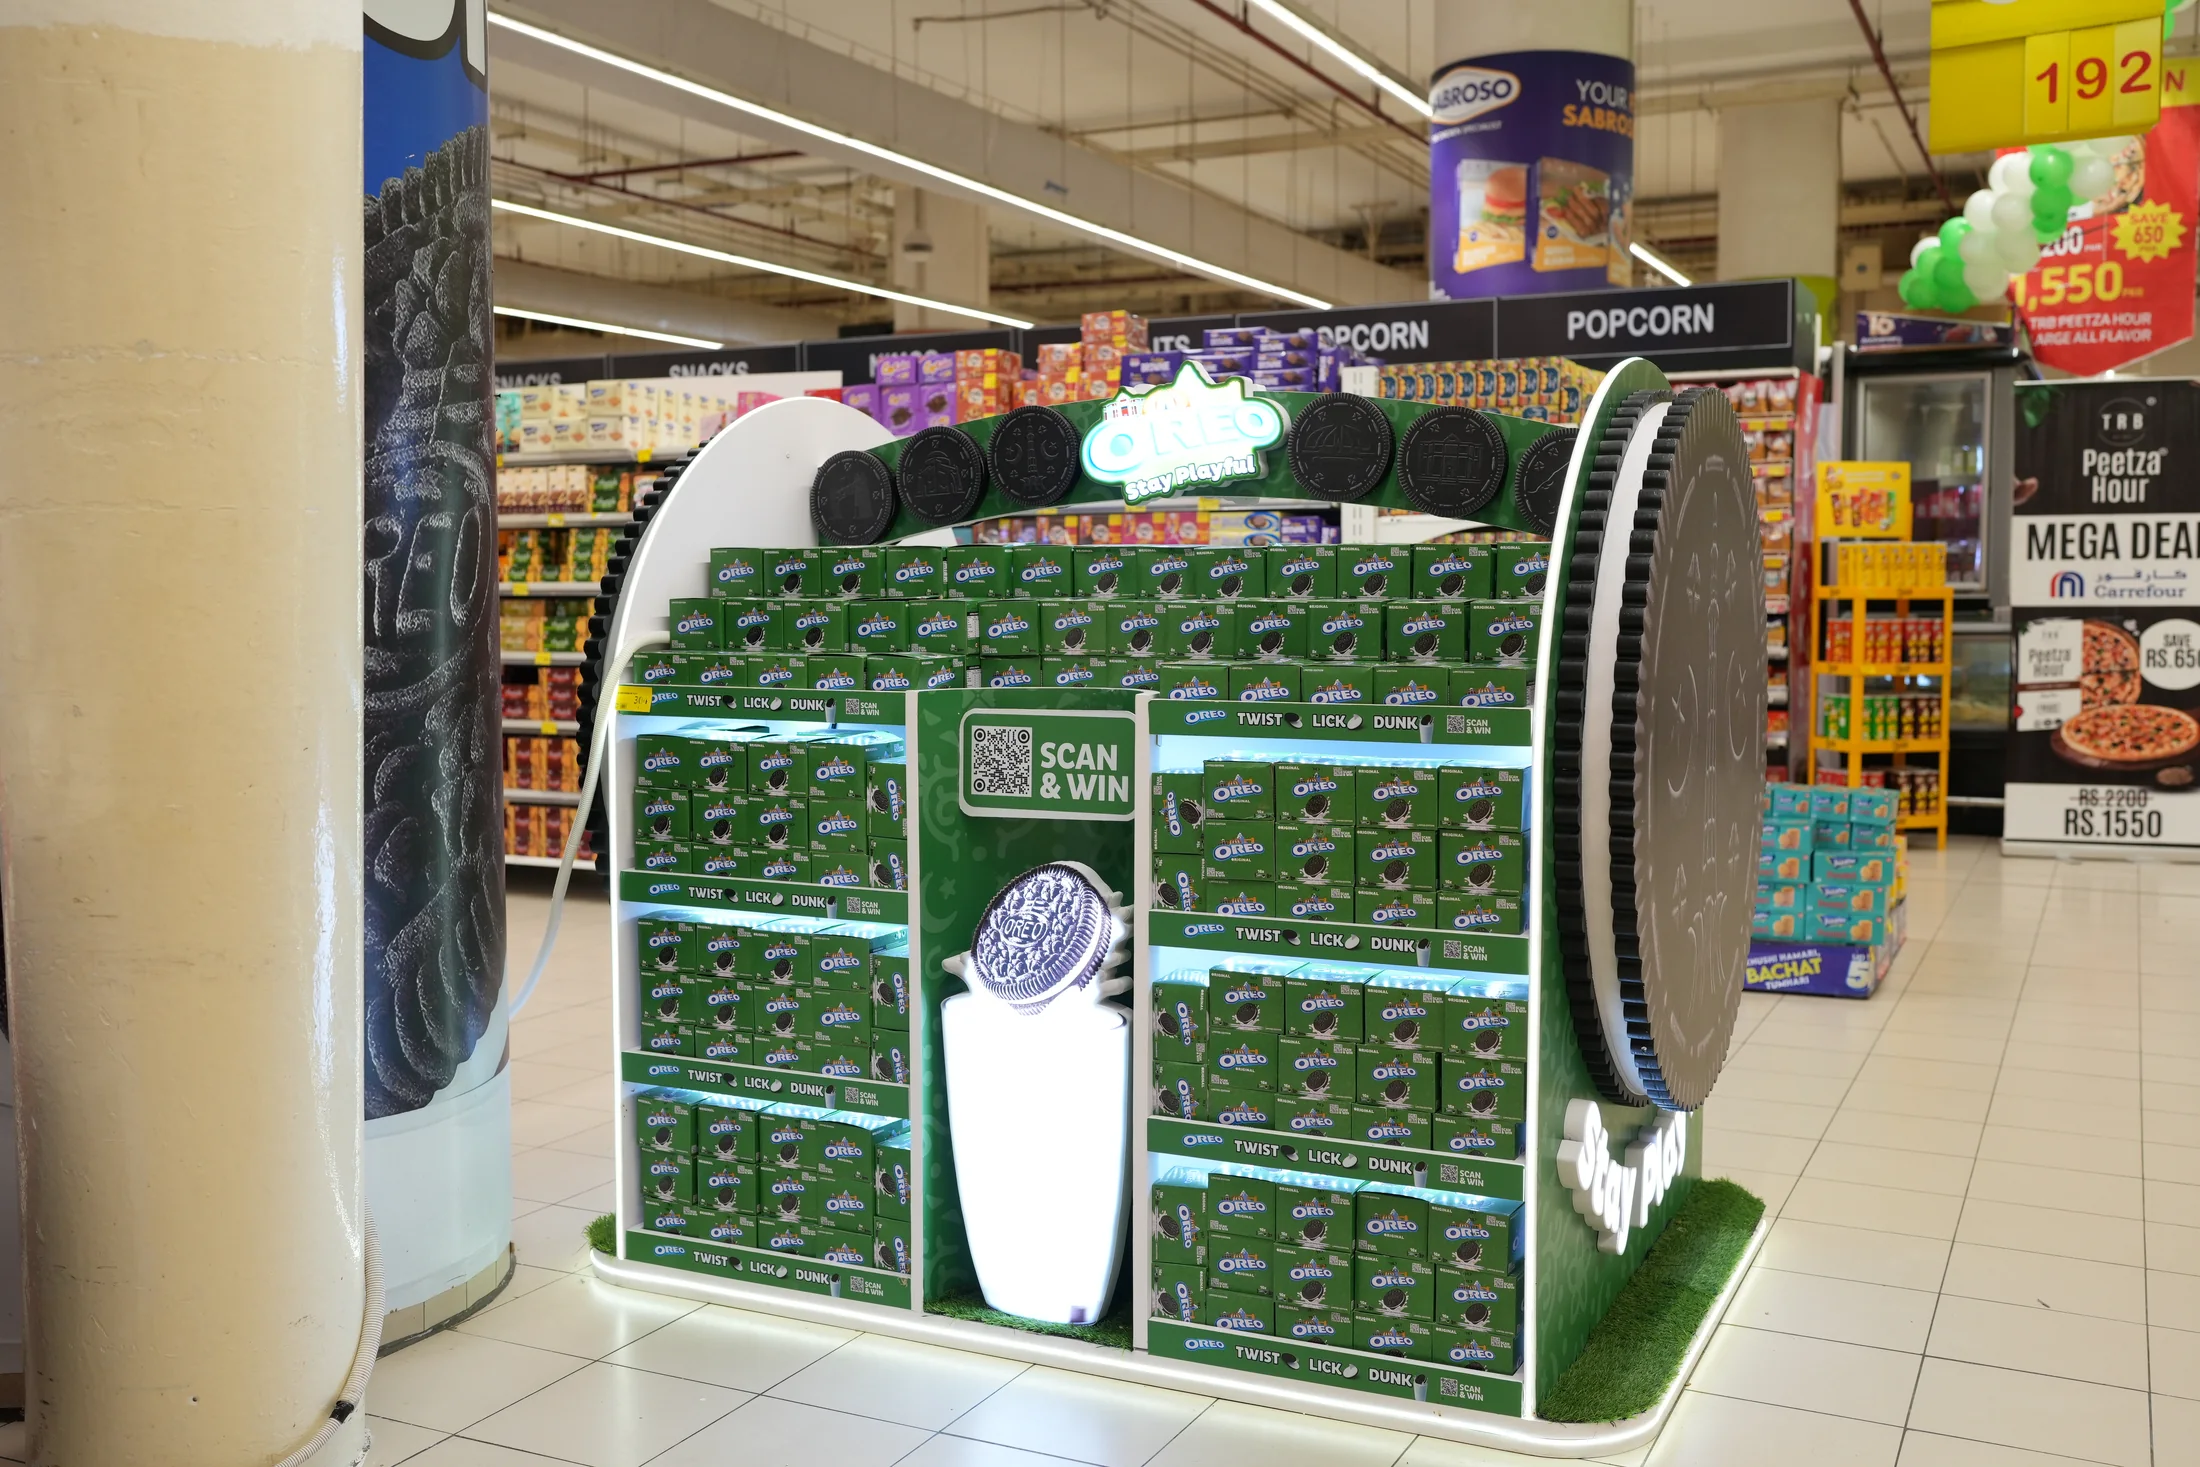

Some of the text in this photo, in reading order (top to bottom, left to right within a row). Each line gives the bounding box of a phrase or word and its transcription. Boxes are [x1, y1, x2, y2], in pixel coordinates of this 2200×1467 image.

[2036, 51, 2152, 104] 192
[1433, 79, 1512, 110] ABROSO
[1576, 79, 1627, 106] YOUR
[2130, 213, 2168, 225] SAVE
[2133, 226, 2164, 244] 650
[2011, 261, 2123, 312] 1,550
[1567, 303, 1714, 340] POPCORN
[2058, 314, 2111, 329] PEETZA
[2112, 312, 2152, 326] HOUR
[2034, 328, 2152, 346] ARGE ALL FLAVOR
[1089, 404, 1277, 473] OREO
[2082, 448, 2161, 477] Peetza
[1125, 455, 1256, 501] Stay Playful
[2092, 476, 2149, 503] Hour
[2027, 521, 2200, 560] MEGA DEA
[718, 565, 754, 583] OREO
[895, 565, 933, 583] OREO
[954, 565, 996, 583] OREO
[1021, 565, 1062, 582] OREO
[1088, 560, 1123, 575] OREO
[1151, 560, 1187, 576] OREO
[1281, 560, 1319, 577] OREO
[1353, 560, 1393, 576] OREO
[2094, 585, 2186, 599] Carrefour
[677, 617, 713, 634] OREO
[856, 620, 896, 637] OREO
[987, 620, 1029, 638] OREO
[1054, 615, 1092, 630] OREO
[1250, 618, 1290, 633] OREO
[1402, 619, 1445, 636] OREO
[2163, 634, 2191, 647] SAVE
[687, 695, 721, 706] TWIST
[744, 697, 769, 709] LICK
[790, 699, 824, 711] DUNK
[1185, 710, 1417, 730] OREO TWIST LICK DUNK
[644, 756, 679, 769] OREO
[760, 757, 792, 769] OREO
[1040, 742, 1117, 771] SCAN
[816, 765, 855, 779] OREO
[1039, 771, 1128, 802] & WIN
[1213, 784, 1262, 801] OREO
[1293, 781, 1337, 797] OREO
[1373, 784, 1418, 799] OREO
[1455, 785, 1502, 801] OREO
[2079, 789, 2148, 807] RS.2200
[1167, 792, 1181, 836] OREO
[818, 820, 857, 833] OREO
[2064, 809, 2162, 838] RS.1550
[1214, 842, 1264, 860] OREO
[1371, 845, 1415, 861] OREO
[649, 883, 825, 908] OREO TWIST LICK DUNK
[1003, 919, 1044, 939] OREO
[1184, 924, 1415, 952] OREO TWIST LICK DUNK
[765, 948, 796, 959] OREO
[1463, 946, 1484, 954] SCAN
[1471, 953, 1488, 961] WIN
[820, 957, 859, 970] OREO
[1746, 959, 1822, 983] BACHAT
[1225, 991, 1266, 1003] OREO
[1302, 998, 1344, 1011] OREO
[1381, 1006, 1426, 1020] OREO
[1176, 1002, 1191, 1046] OREO
[1462, 1016, 1509, 1030] OREO
[1219, 1054, 1267, 1068] OREO
[649, 1065, 824, 1096] OREO TWIST LICK DUNK
[866, 1098, 878, 1106] WIN
[710, 1124, 741, 1133] OREO
[825, 1147, 862, 1158] OREO
[1183, 1134, 1412, 1174] OREO TWIST LICK DUNK
[1460, 1170, 1481, 1179] SCAN
[1468, 1178, 1484, 1187] WIN
[1577, 1101, 1637, 1256] Stay
[1217, 1200, 1266, 1214] OREO
[1292, 1206, 1334, 1219] OREO
[1177, 1204, 1191, 1248] OREO
[1366, 1219, 1418, 1232] OREO
[1445, 1227, 1489, 1240] OREO
[655, 1246, 829, 1284] OREO TWIST LICK DUNK
[1184, 1338, 1412, 1386] OREO TWIST LICK DUNK
[1459, 1384, 1481, 1392] SCAN
[1468, 1392, 1484, 1401] WIN
